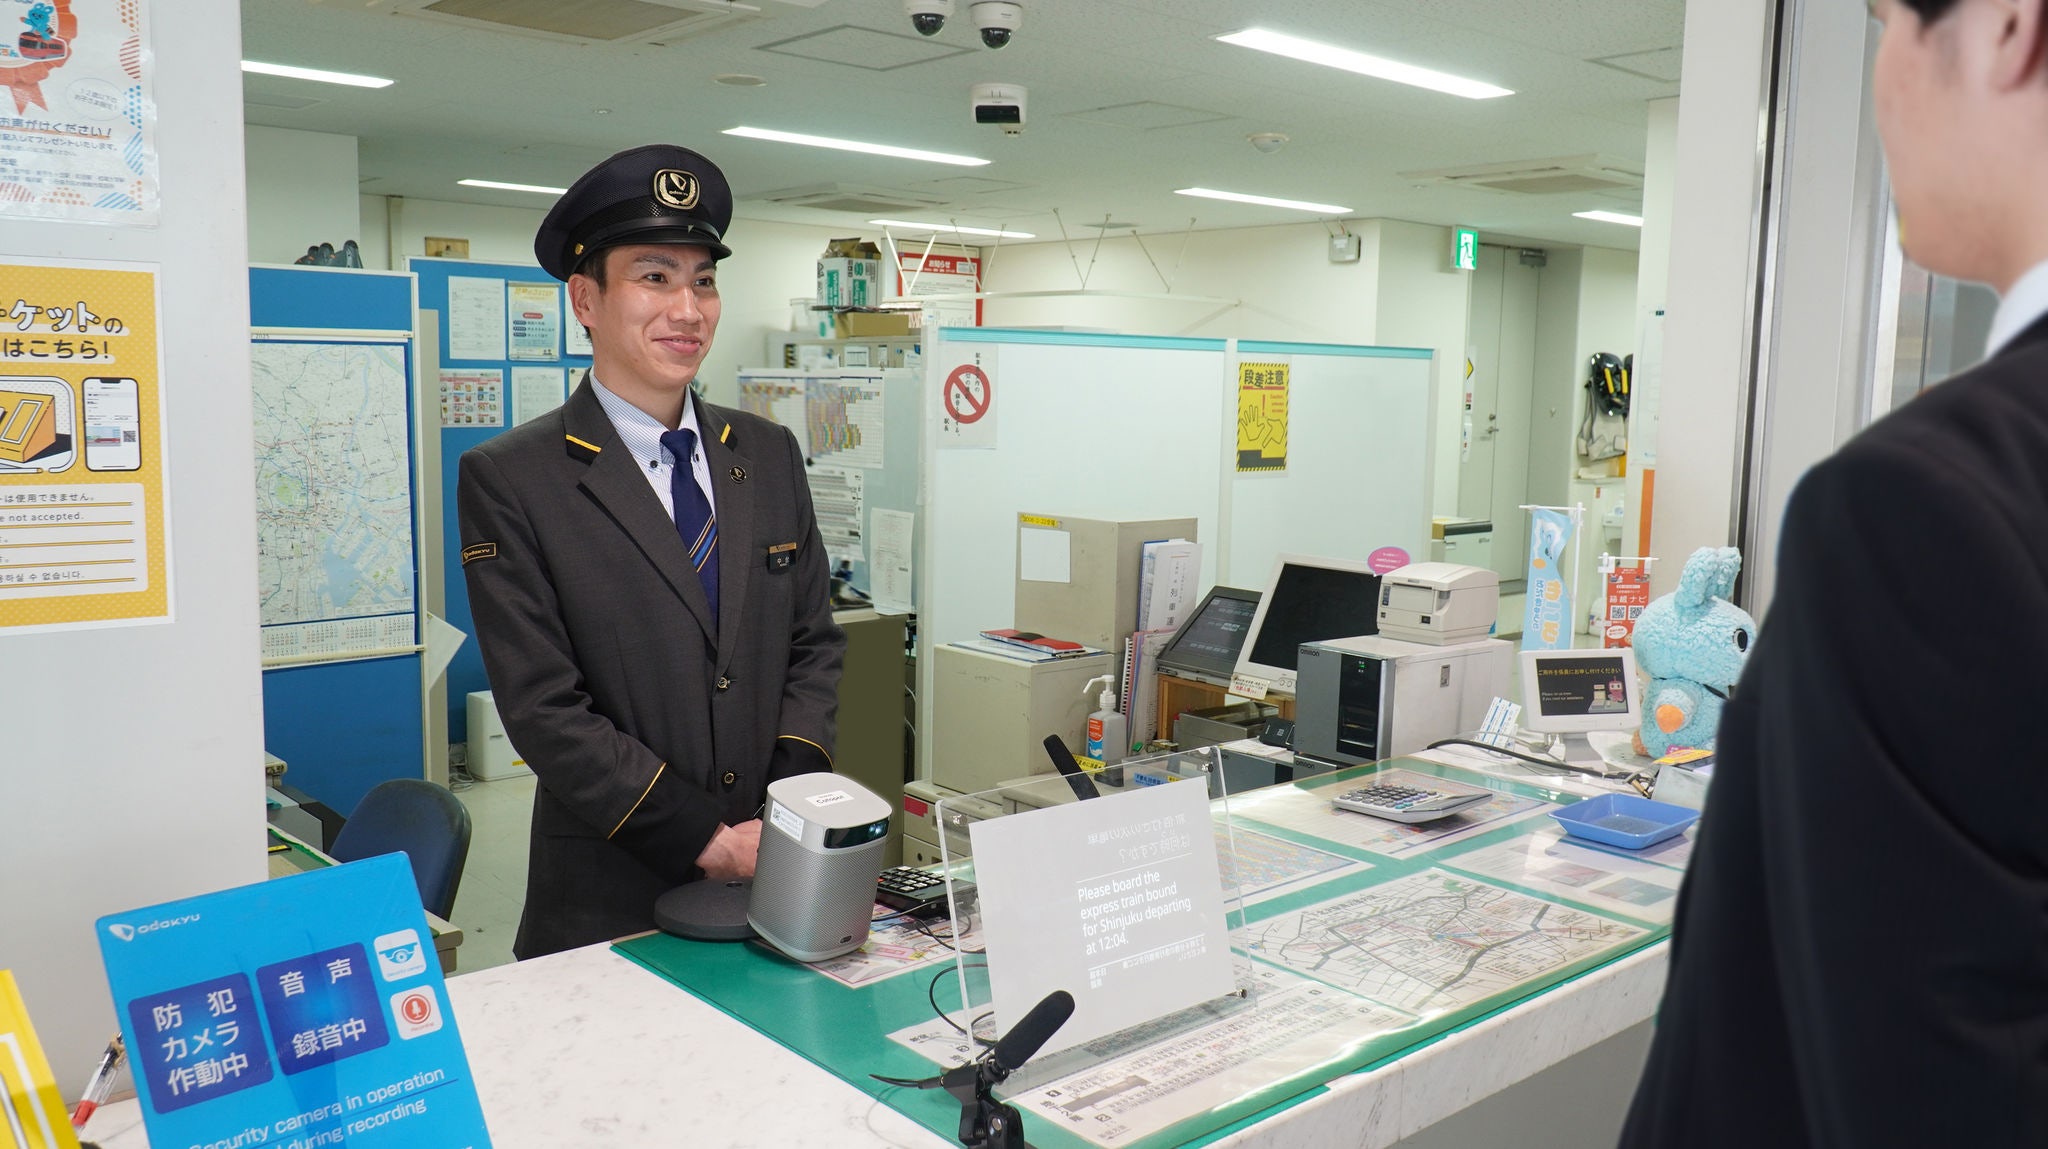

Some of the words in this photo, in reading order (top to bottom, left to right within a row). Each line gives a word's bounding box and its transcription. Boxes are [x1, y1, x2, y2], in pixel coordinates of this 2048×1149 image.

[0, 299, 123, 333] ケットの
[3, 338, 109, 360] はこちら!
[1244, 369, 1285, 389] 段差注意
[9, 514, 27, 522] not
[31, 511, 84, 522] accepted.
[1078, 884, 1111, 902] Please
[1112, 874, 1142, 893] board
[1144, 871, 1160, 885] the
[1080, 899, 1119, 920] express
[1120, 892, 1144, 909] train
[1145, 881, 1177, 902] bound
[137, 913, 201, 935] odakyu
[1082, 923, 1098, 937] for
[1100, 911, 1143, 933] Shinjuku
[1144, 897, 1192, 920] departing
[1086, 941, 1098, 955] at
[1098, 932, 1129, 950] 12:04.
[162, 1020, 241, 1062] カメラ
[291, 1018, 368, 1059] 録音中
[167, 1052, 249, 1097] 作動中
[274, 1101, 343, 1135] camera
[345, 1094, 363, 1111] in
[367, 1068, 445, 1104] operation
[287, 1127, 344, 1149] during
[347, 1098, 428, 1136] recording
